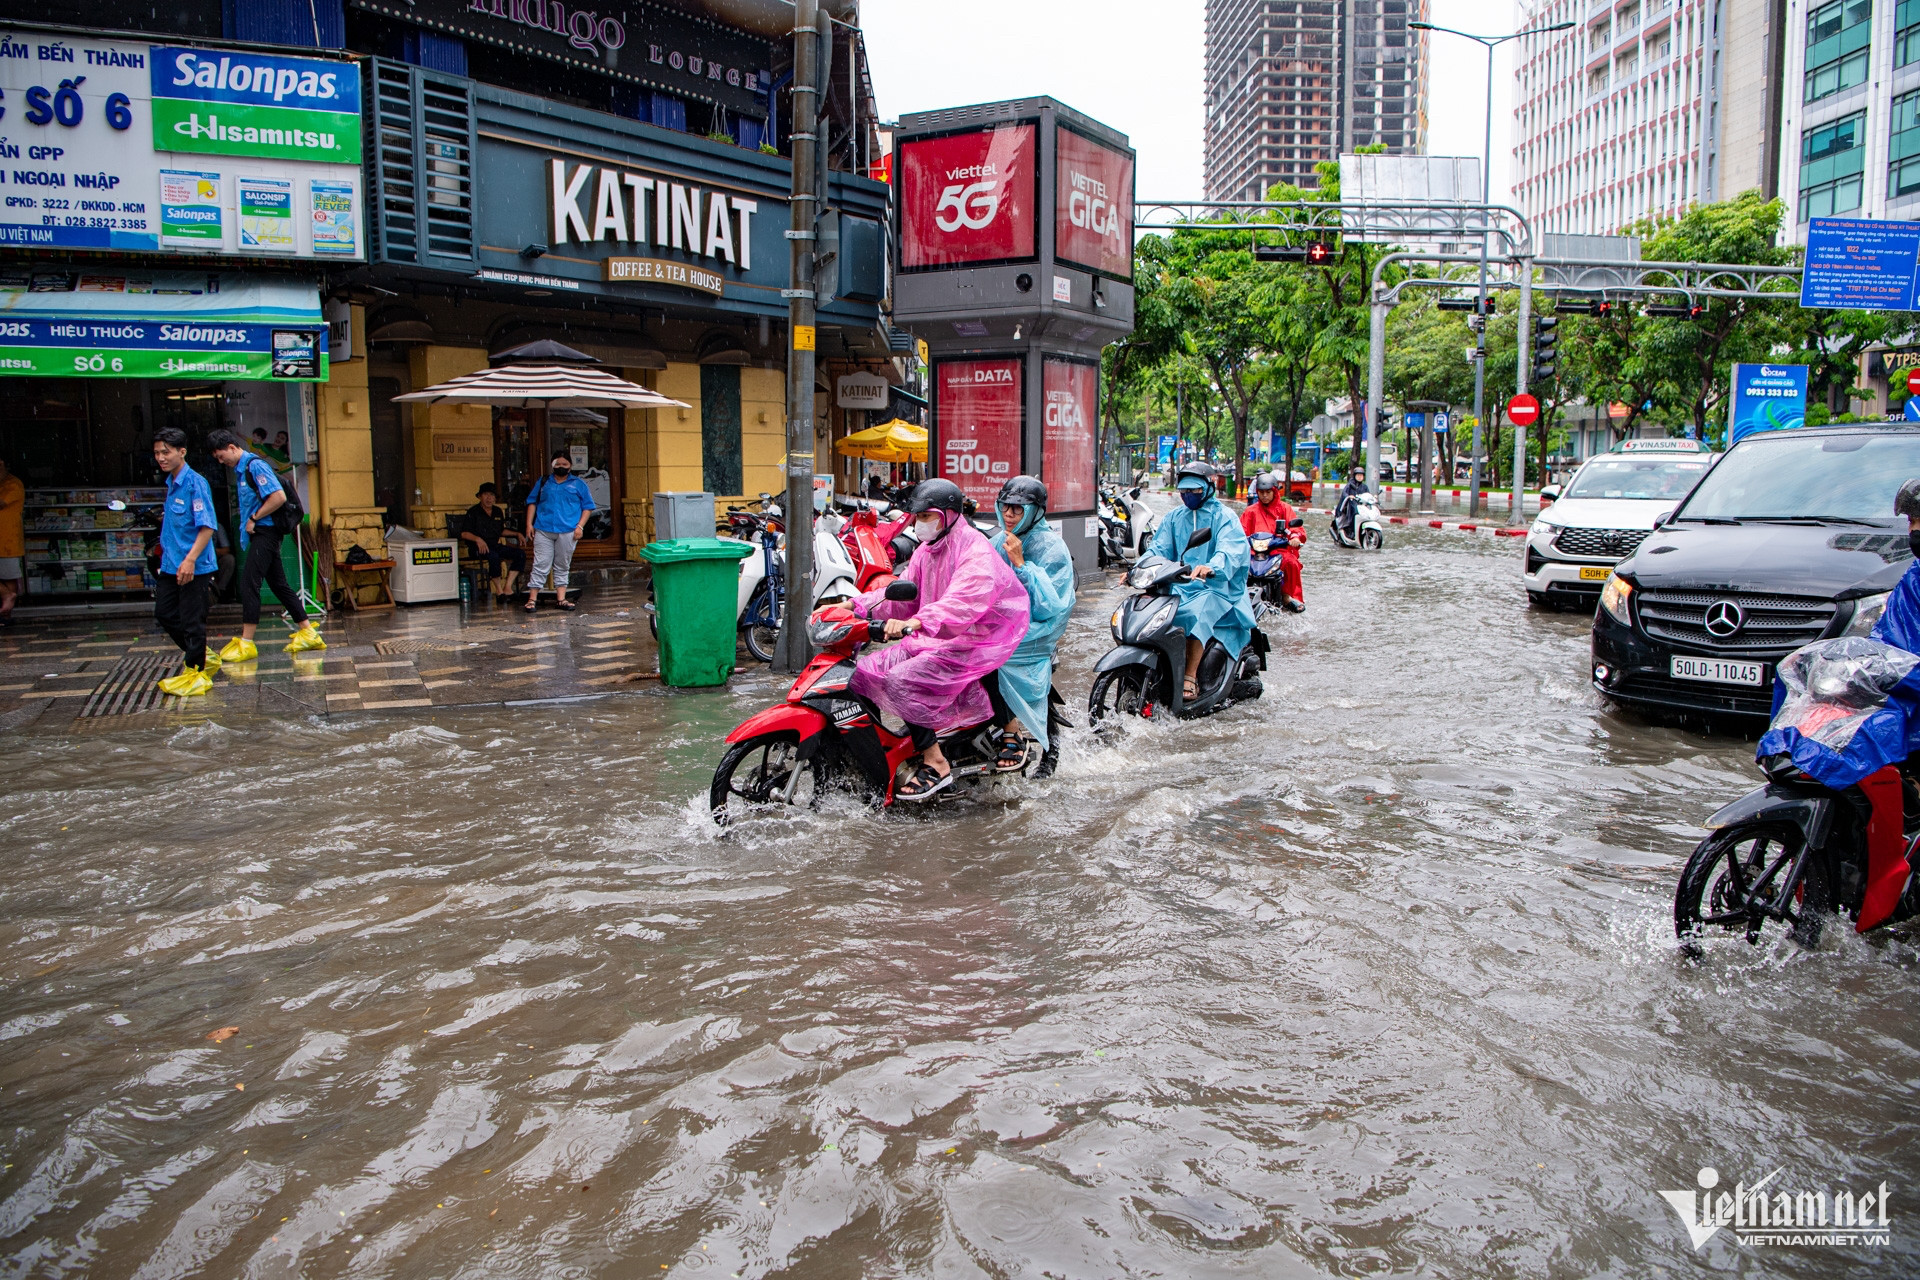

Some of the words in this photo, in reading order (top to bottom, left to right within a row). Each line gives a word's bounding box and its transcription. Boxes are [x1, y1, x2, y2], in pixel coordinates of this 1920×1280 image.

[38, 42, 74, 62] BẾN
[84, 48, 144, 68] THÀNH
[649, 44, 758, 91] LOUNGE
[26, 76, 86, 126] SỐ
[106, 92, 132, 130] 6
[28, 146, 64, 160] GPP
[14, 170, 66, 189] NGOẠI
[74, 172, 120, 192] NHẬP
[946, 162, 998, 180] viettel
[1070, 170, 1108, 200] VIETTEL
[6, 196, 37, 208] GPKD:
[42, 198, 69, 210] 3222
[936, 181, 998, 232] 5G
[42, 215, 60, 226] ĐT:
[66, 216, 146, 230] 028.3822.3385
[167, 208, 217, 221] Salonpas
[551, 158, 758, 271] KATINAT
[1069, 190, 1120, 240] GIGA
[8, 226, 29, 243] VIỆT
[31, 229, 52, 242] NAM
[612, 261, 652, 277] COFFEE
[655, 264, 664, 279] &
[666, 264, 686, 282] TEA
[690, 270, 722, 292] HOUSE
[51, 324, 87, 338] HIỆU
[90, 325, 145, 339] THUỐC
[159, 324, 247, 345] Salonpas
[74, 353, 106, 372] SỐ
[111, 357, 124, 372] 6
[975, 369, 1013, 382] DATA
[841, 385, 883, 398] KATINAT
[1746, 388, 1765, 396] 0933
[1046, 403, 1083, 427] GIGA
[946, 454, 989, 474] 300
[1676, 660, 1756, 681] 50LD-110.45
[833, 704, 862, 720] YAMAHA
